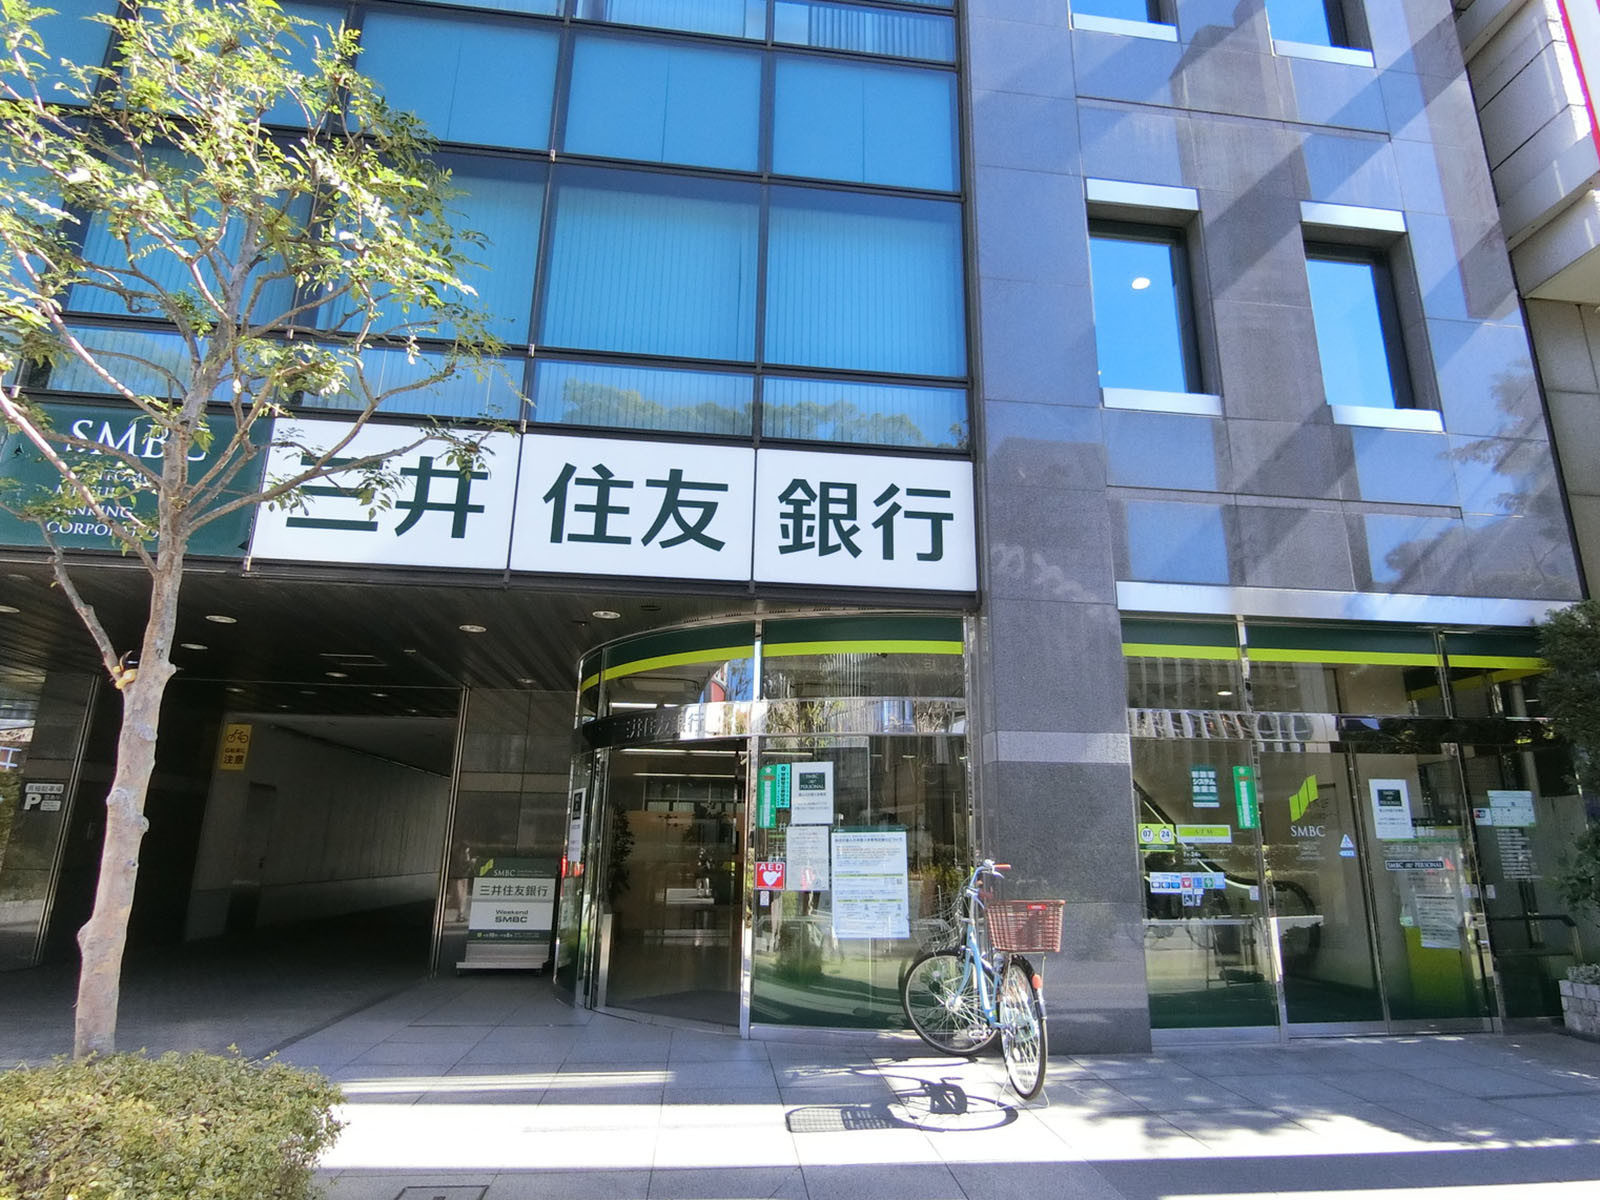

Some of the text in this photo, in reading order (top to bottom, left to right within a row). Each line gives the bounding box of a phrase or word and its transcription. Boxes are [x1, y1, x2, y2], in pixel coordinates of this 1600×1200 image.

[284, 453, 954, 563] 三井住友銀行
[223, 754, 244, 765] 注意
[1142, 830, 1170, 838] 07 24
[1290, 825, 1326, 837] SMBC
[494, 868, 516, 877] SMBC
[759, 863, 783, 871] AED
[479, 884, 549, 897] 三井住友銀行
